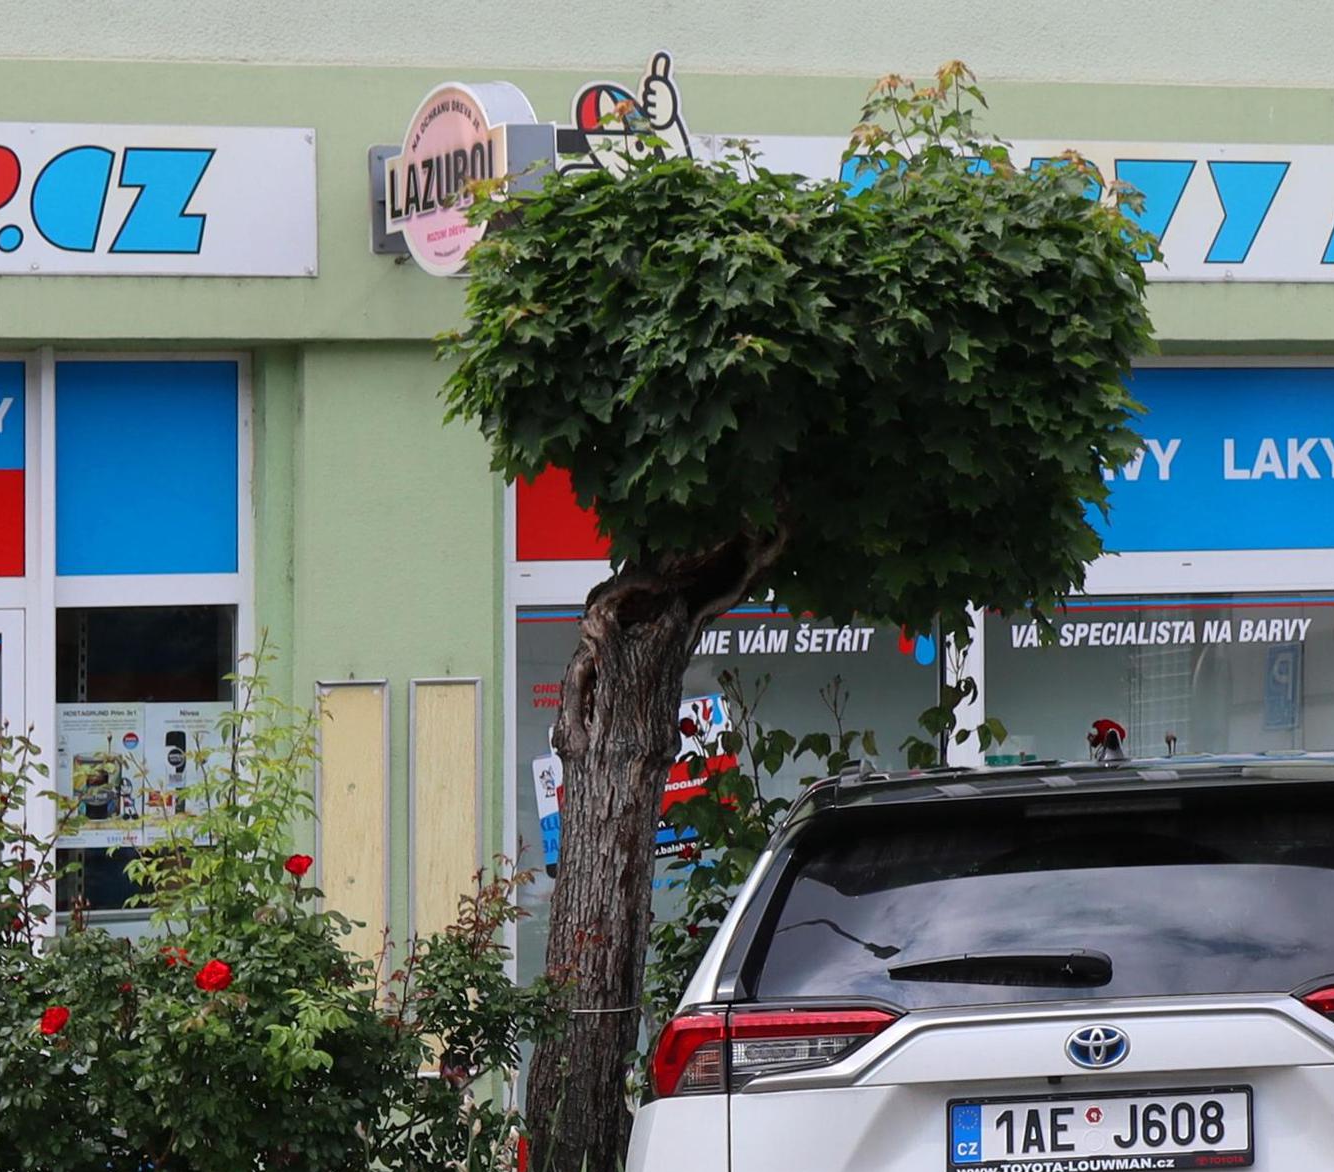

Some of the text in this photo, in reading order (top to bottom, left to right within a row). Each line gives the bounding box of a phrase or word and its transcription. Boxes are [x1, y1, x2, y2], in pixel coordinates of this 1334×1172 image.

[738, 624, 789, 654] VÁM
[1011, 618, 1312, 648] VÁ SPECIALISTA NA BARVY
[995, 1100, 1225, 1154] 1AE J608
[957, 1142, 978, 1156] CZ
[1209, 1155, 1244, 1165] TOYOTA
